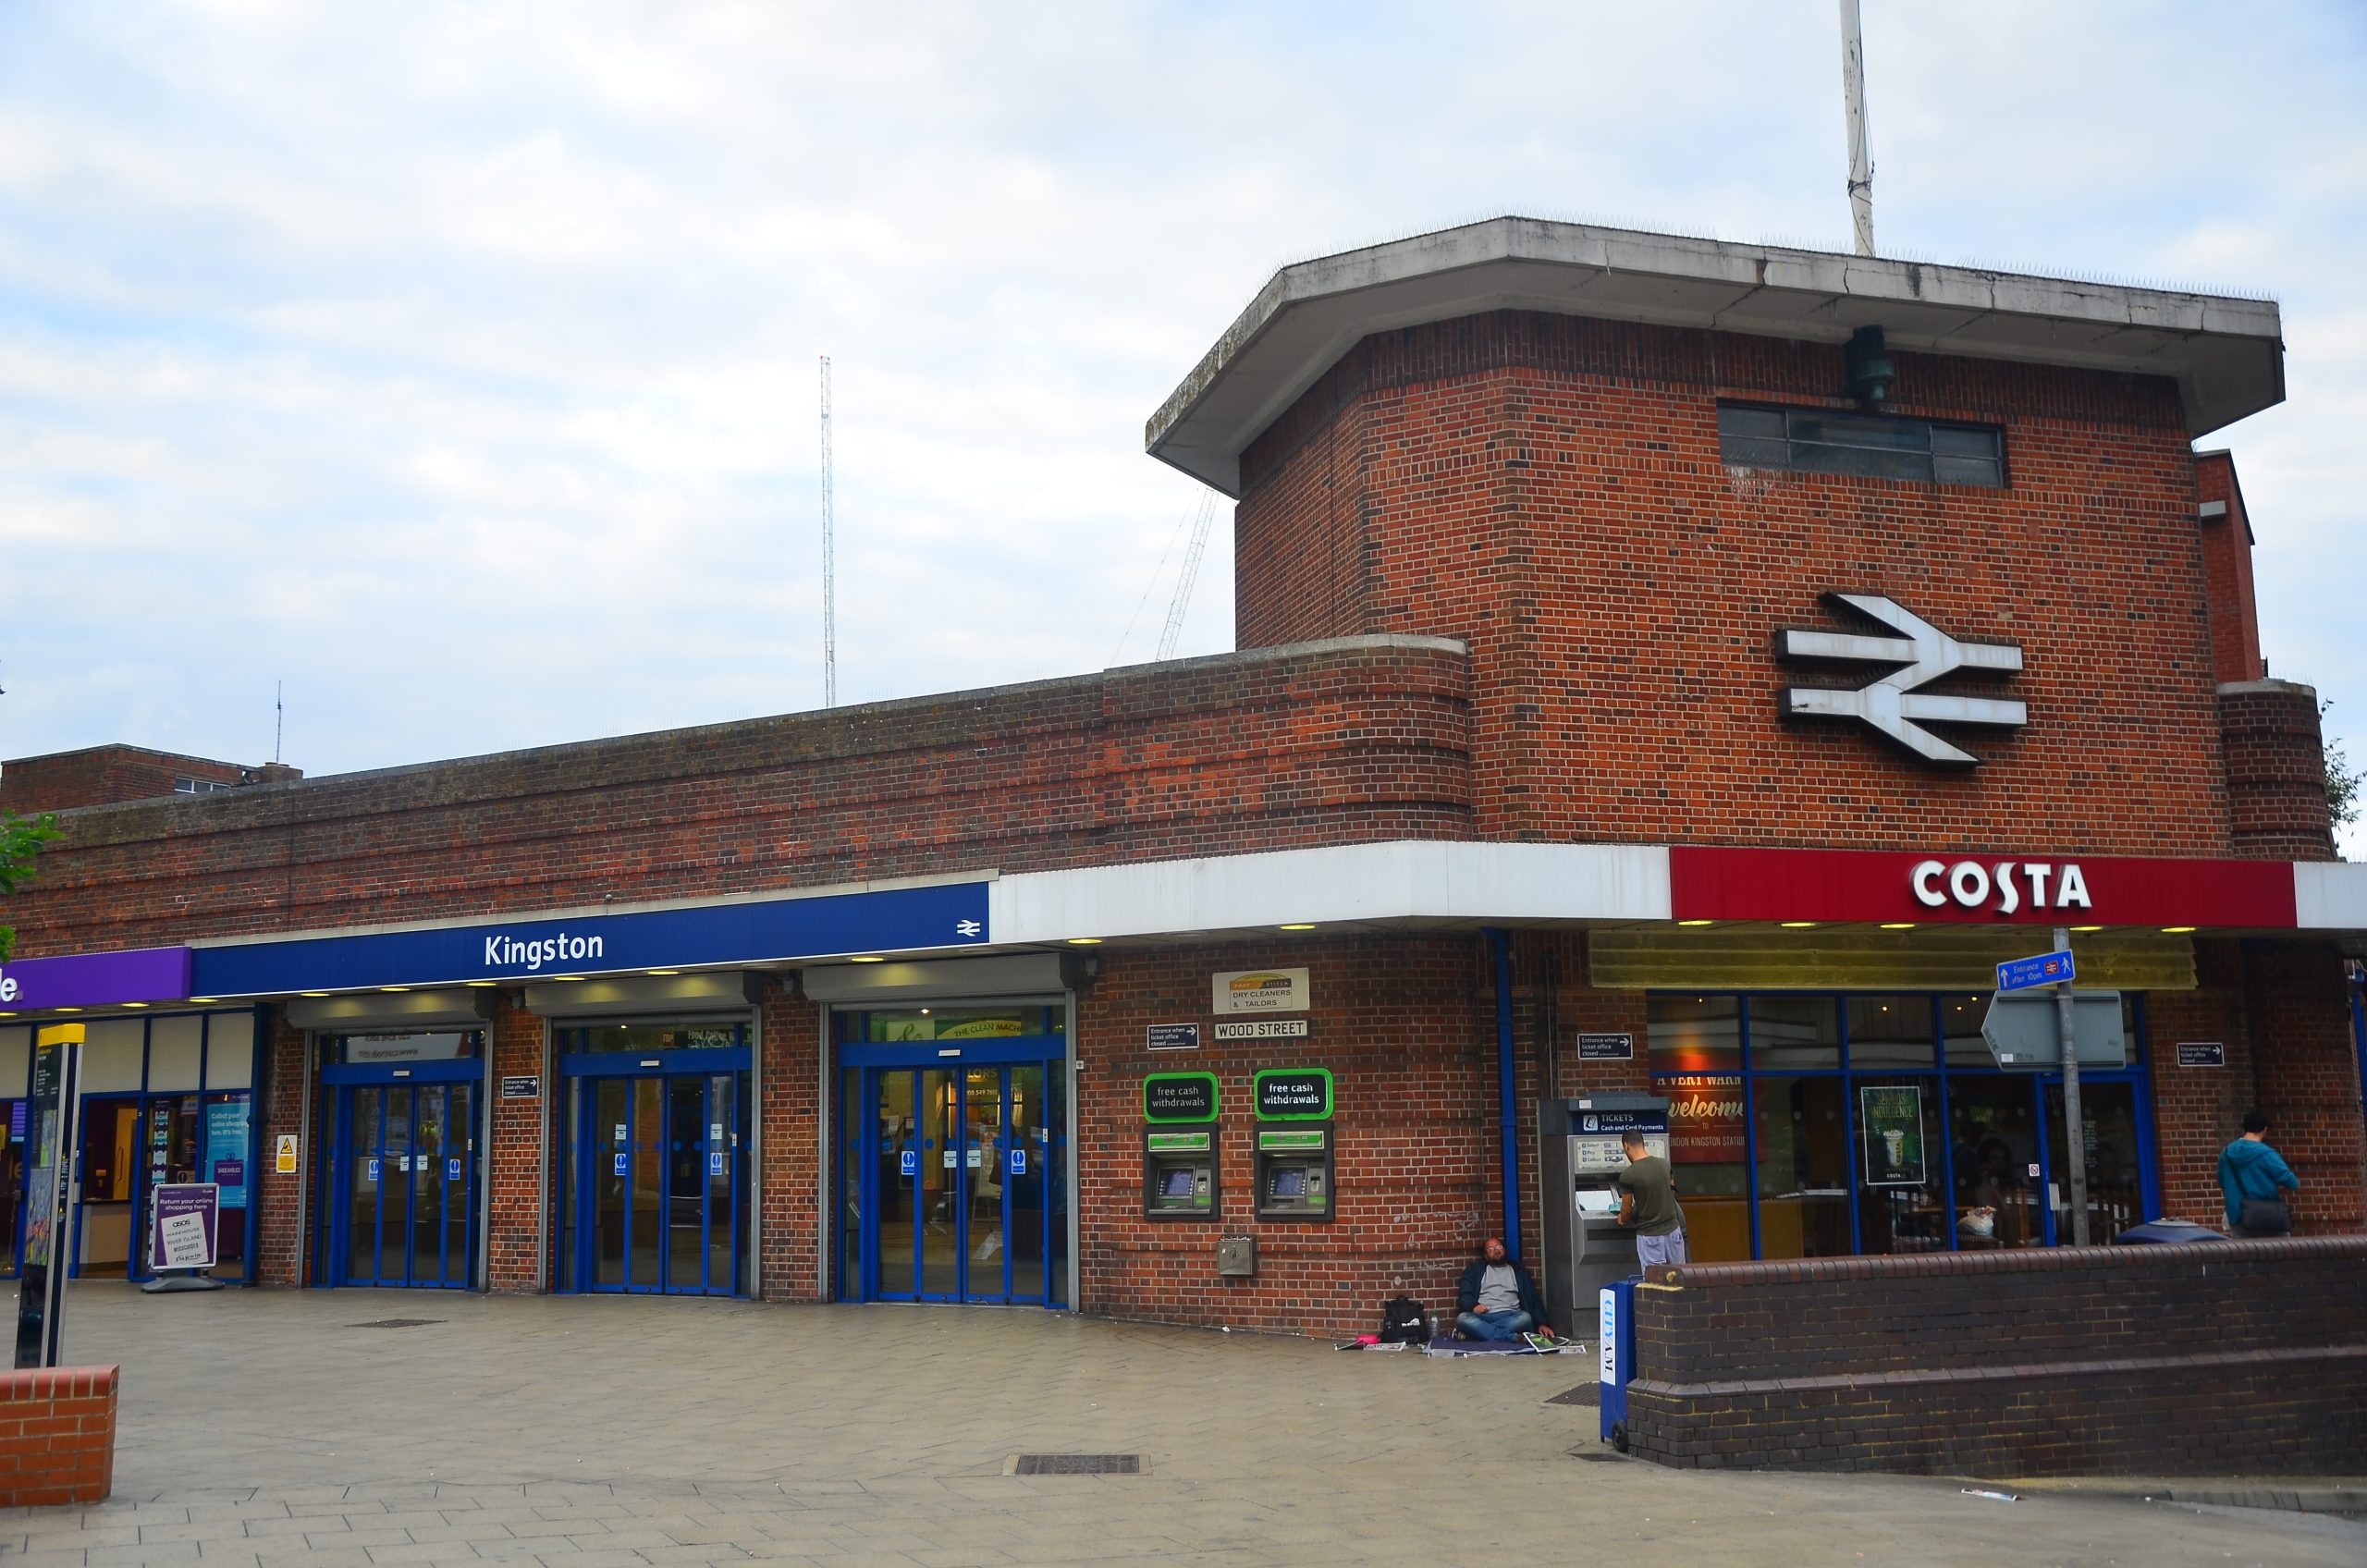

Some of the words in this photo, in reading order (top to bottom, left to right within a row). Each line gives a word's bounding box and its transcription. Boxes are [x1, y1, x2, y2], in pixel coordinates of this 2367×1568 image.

[1910, 860, 2092, 914] COSTA
[485, 933, 603, 970] Kingston
[2013, 963, 2040, 974] Entrance
[2028, 973, 2042, 981] 10pm
[1250, 989, 1291, 998] CLEANERS
[954, 1027, 970, 1037] THE
[970, 1024, 994, 1034] CLEAN
[996, 1023, 1022, 1032] MACH
[1219, 1024, 1254, 1036] WOOD
[1258, 1023, 1304, 1035] STREET
[967, 1068, 998, 1078] LORS
[1657, 1077, 1666, 1085] A
[1158, 1086, 1175, 1096] free
[1178, 1085, 1199, 1095] cash
[1269, 1083, 1288, 1093] free
[1291, 1083, 1313, 1092] cash
[1152, 1096, 1205, 1108] withdrawals
[1263, 1094, 1319, 1105] withdrawals
[1669, 1137, 1689, 1146] ONDON
[1691, 1137, 1720, 1146] KINGSTON
[166, 1227, 200, 1237] WAREHOUSE
[1604, 1300, 1613, 1339] CITY
[1604, 1341, 1613, 1373] A.M.
